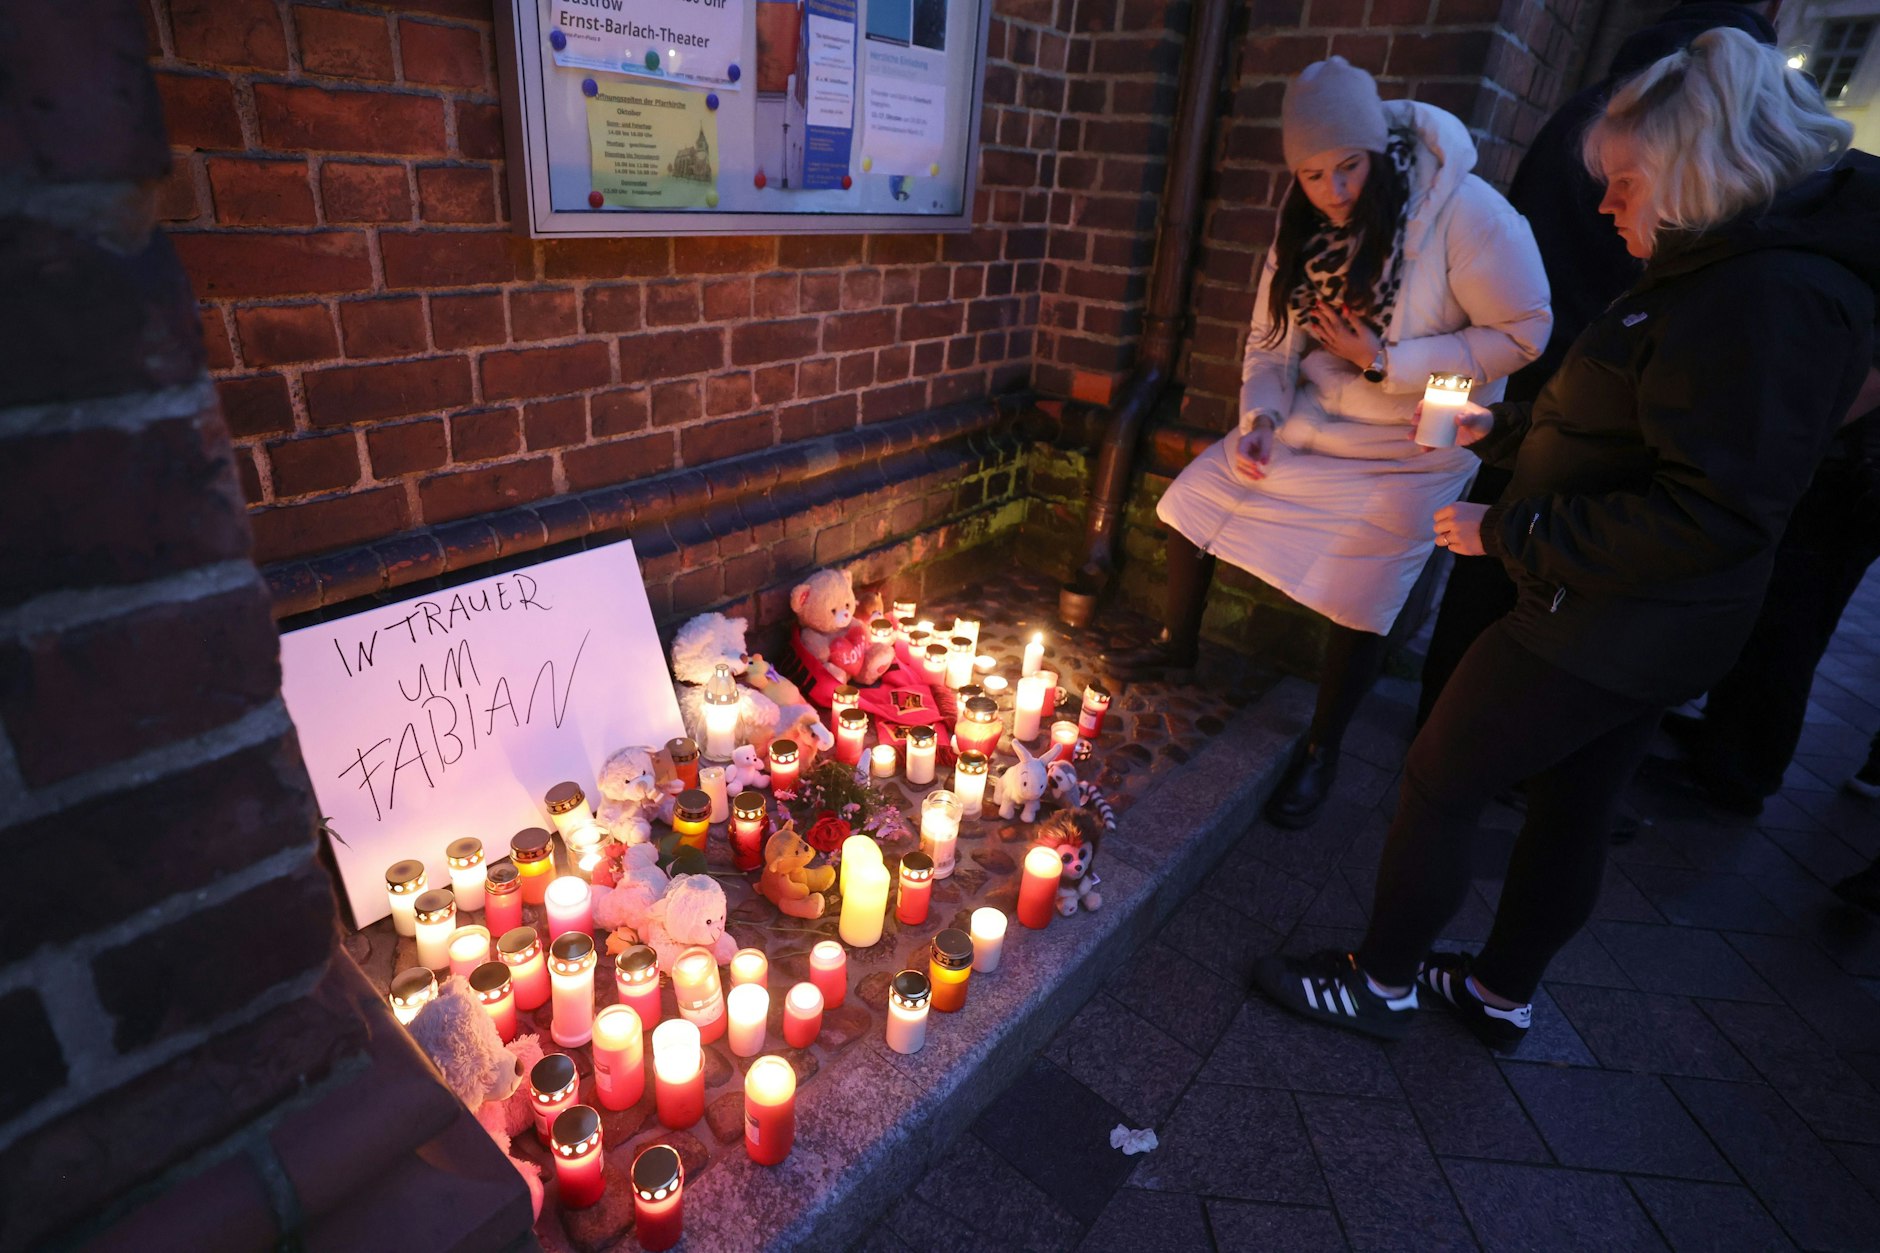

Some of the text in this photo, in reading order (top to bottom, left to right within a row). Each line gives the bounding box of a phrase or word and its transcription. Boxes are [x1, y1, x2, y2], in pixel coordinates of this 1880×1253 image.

[560, 10, 710, 48] Ernst-Barlach-Theater
[562, 0, 622, 11] strow
[617, 108, 641, 116] Oktober
[334, 573, 552, 678] IN TRAUER
[398, 639, 481, 702] UM
[338, 629, 591, 822] FABIAN
